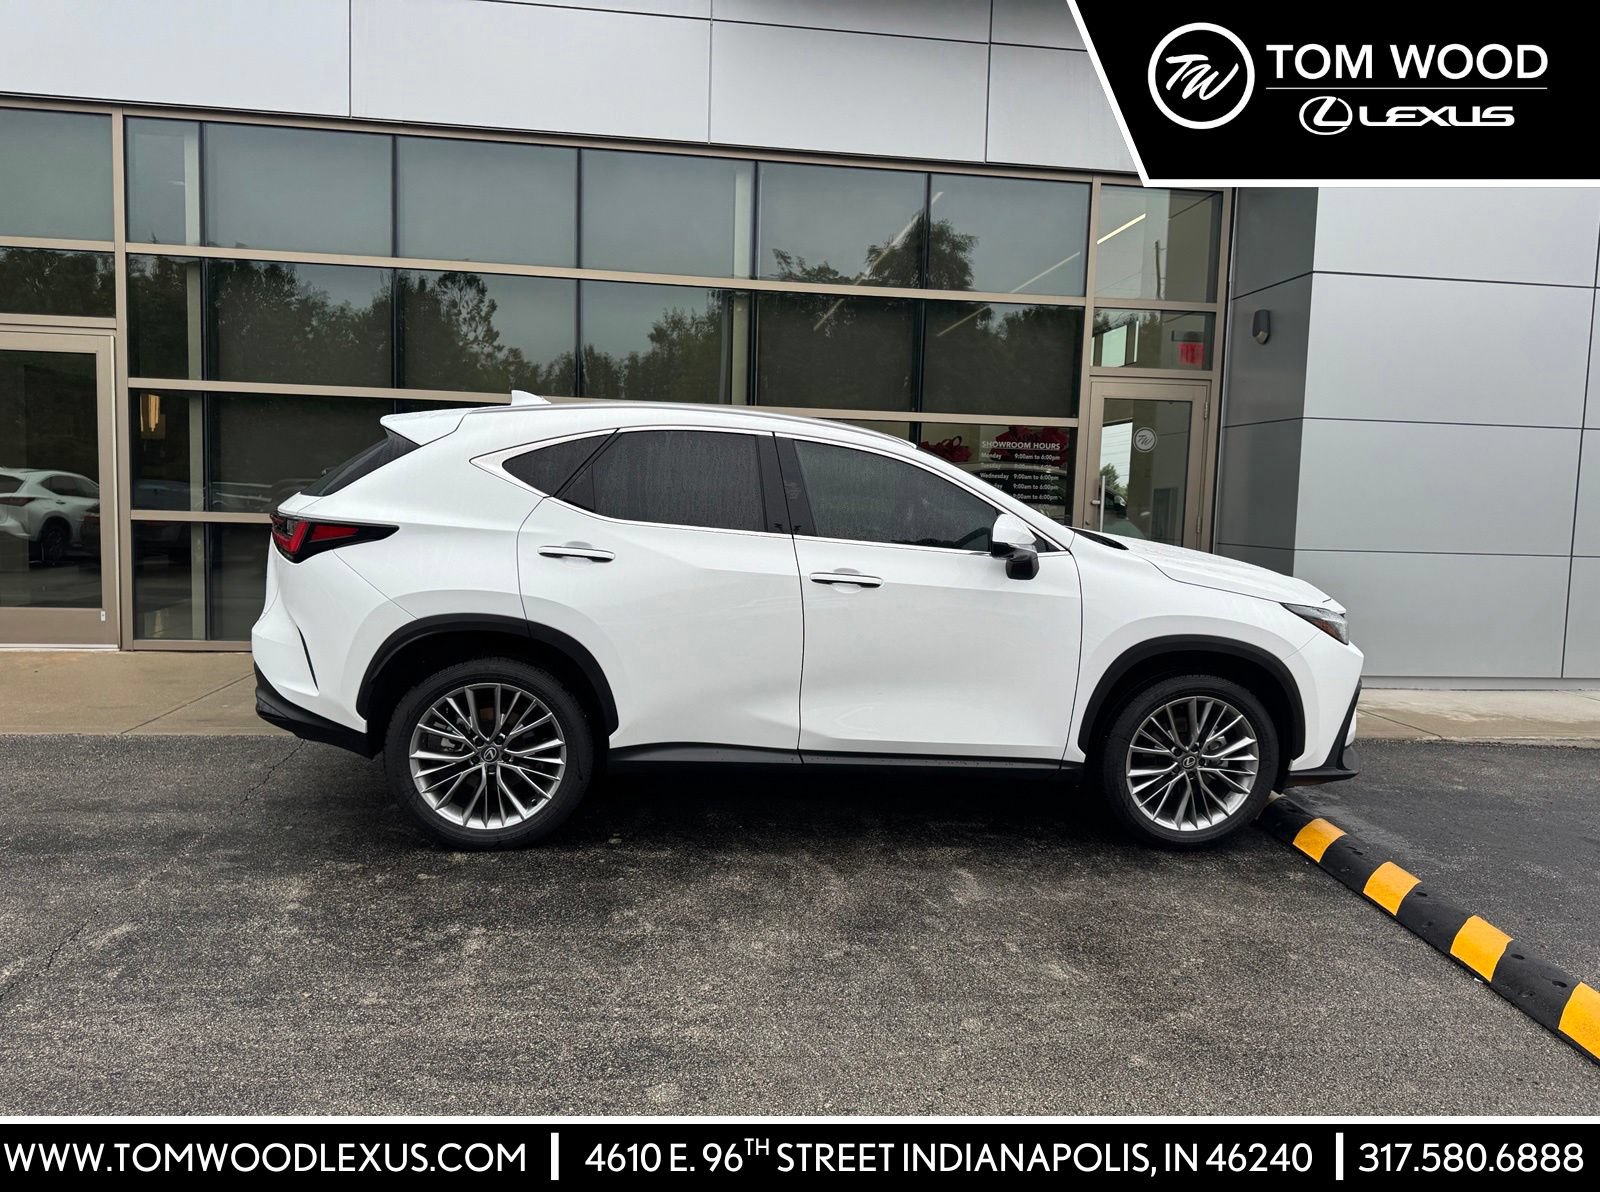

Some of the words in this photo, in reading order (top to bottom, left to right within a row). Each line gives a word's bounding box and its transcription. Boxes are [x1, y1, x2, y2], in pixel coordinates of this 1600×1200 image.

[982, 441, 1031, 449] SHOWROOM
[1033, 442, 1061, 450] HOURS
[980, 472, 1009, 480] Wednesday
